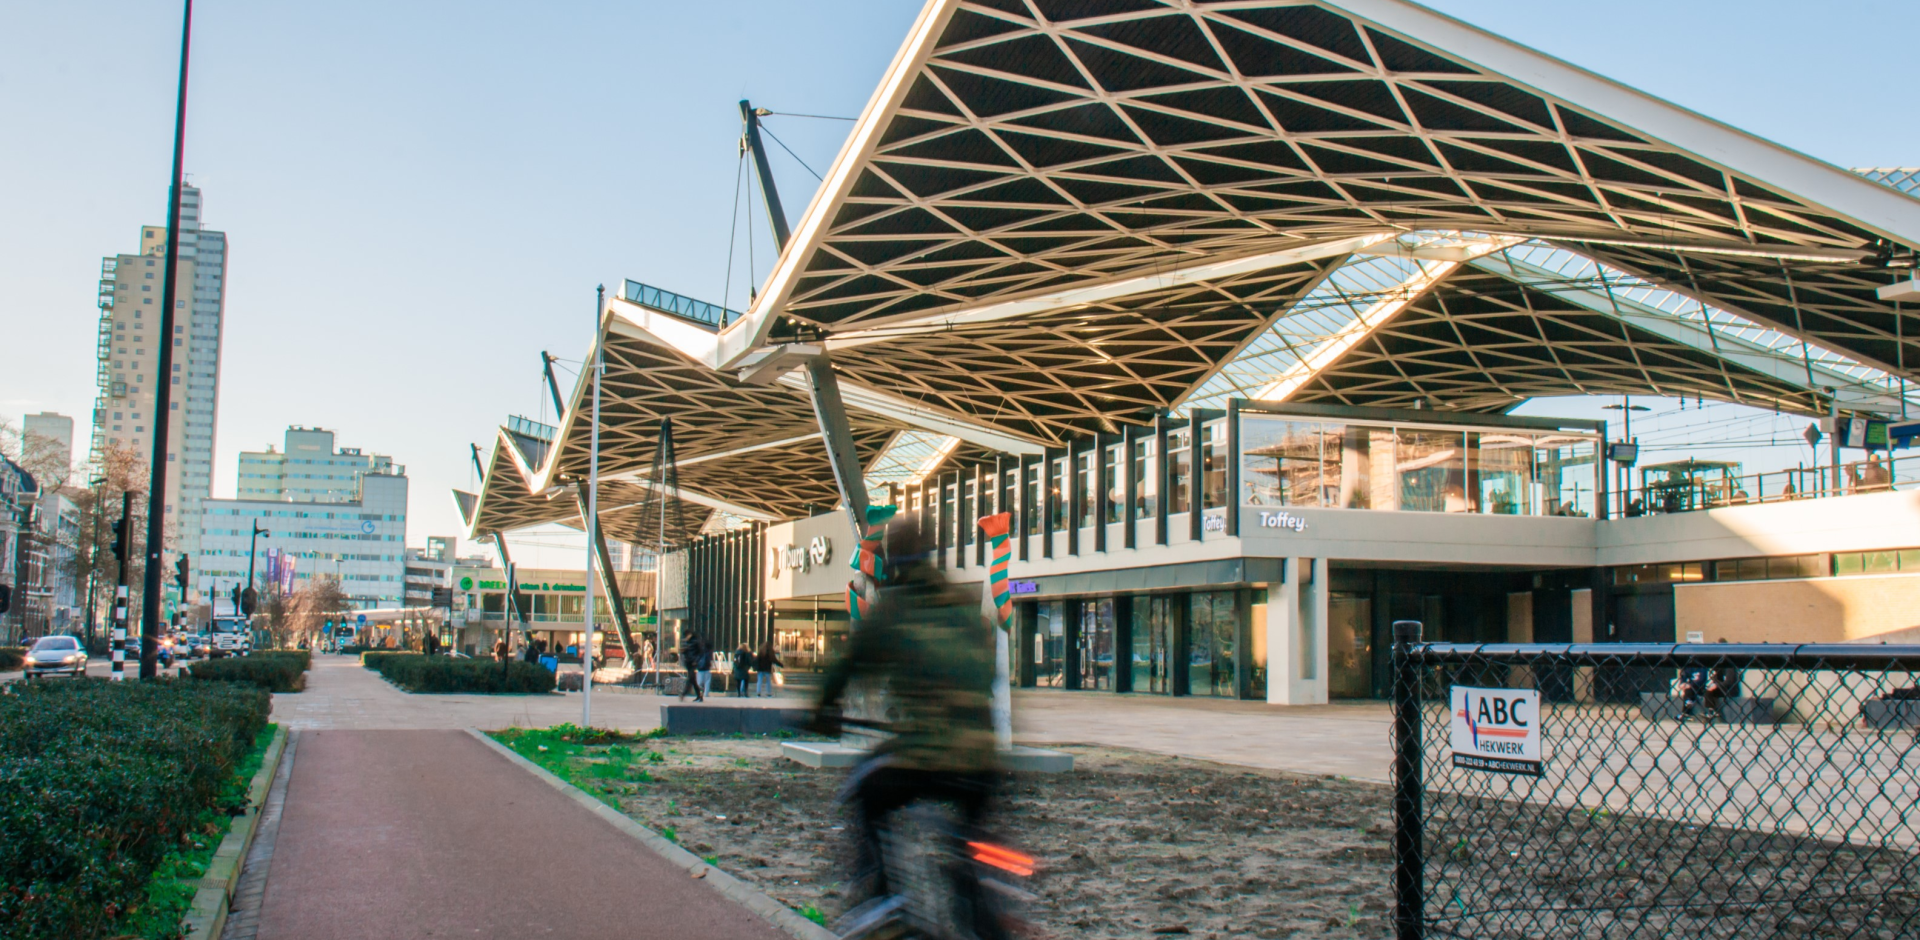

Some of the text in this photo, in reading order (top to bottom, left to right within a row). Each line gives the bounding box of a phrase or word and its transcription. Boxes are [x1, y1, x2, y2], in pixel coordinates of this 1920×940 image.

[1203, 515, 1227, 532] Toffey.
[1259, 512, 1309, 532] Toffey.
[778, 543, 805, 573] Tilburg
[1478, 697, 1528, 727] ABC
[1480, 740, 1524, 755] HEKWERK
[1489, 761, 1535, 772] ABCHEKWERK.NL
